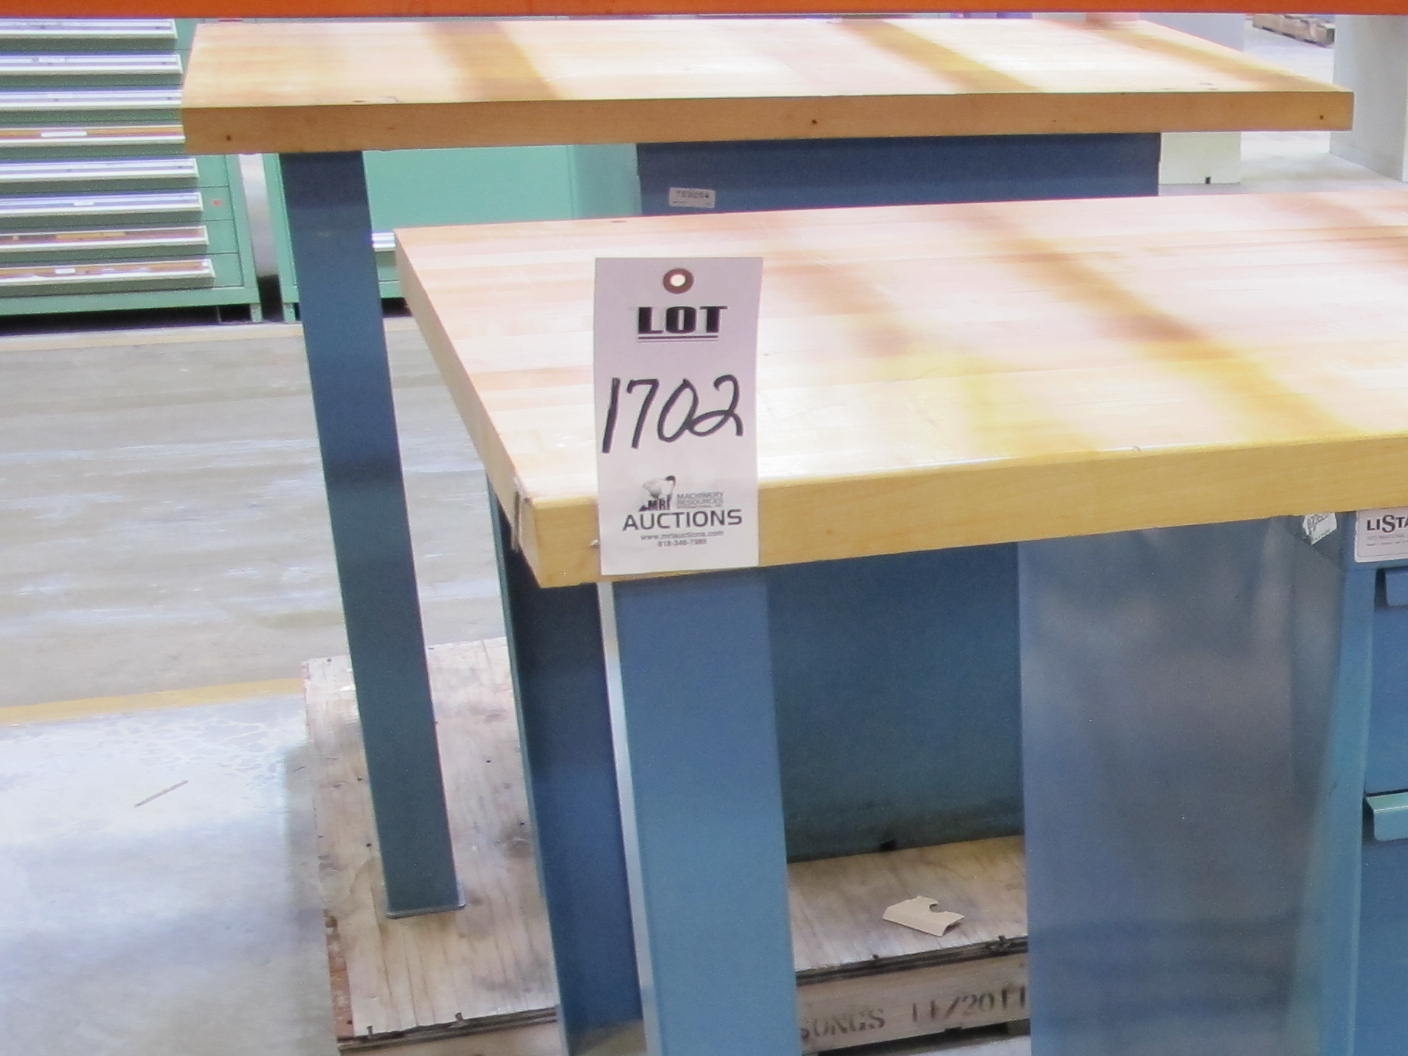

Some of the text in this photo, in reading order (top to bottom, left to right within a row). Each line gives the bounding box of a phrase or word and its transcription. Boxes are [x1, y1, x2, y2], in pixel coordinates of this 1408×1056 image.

[637, 305, 729, 335] LOT
[602, 373, 744, 454] 1702
[622, 508, 743, 532] AUCTIONS
